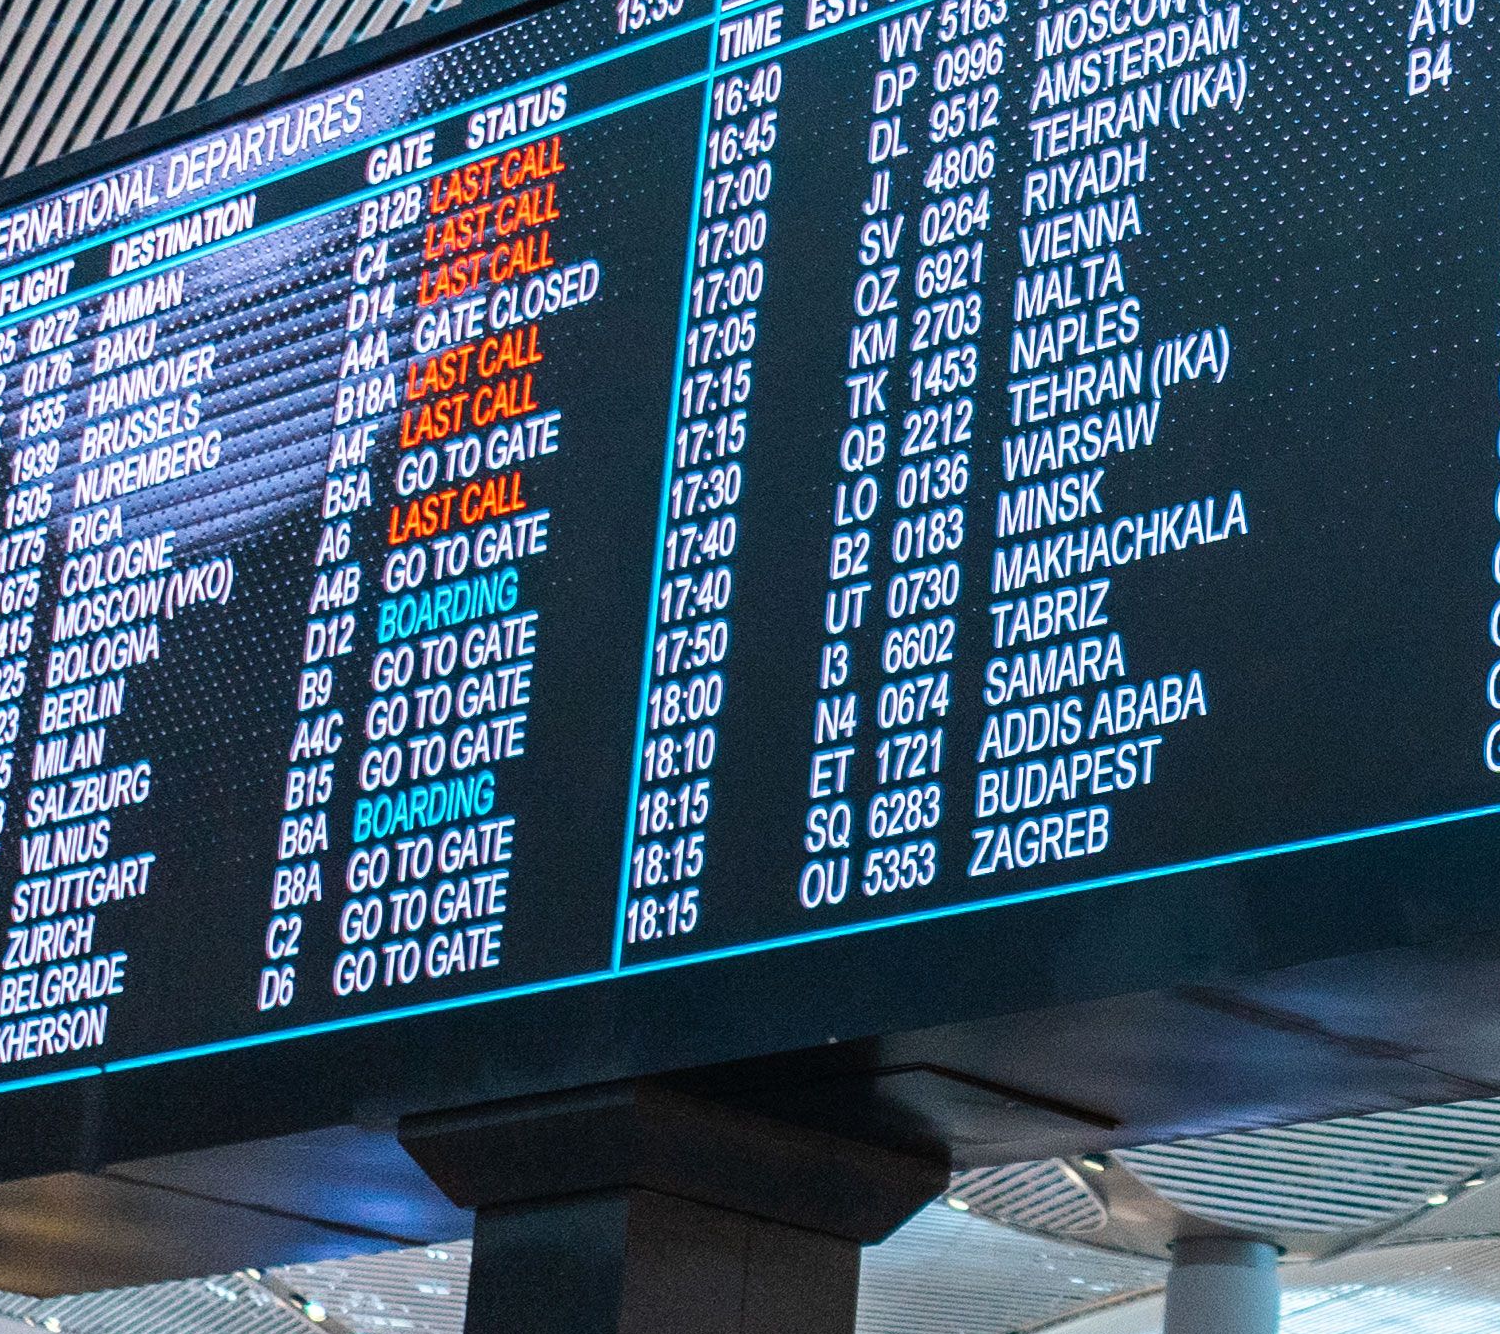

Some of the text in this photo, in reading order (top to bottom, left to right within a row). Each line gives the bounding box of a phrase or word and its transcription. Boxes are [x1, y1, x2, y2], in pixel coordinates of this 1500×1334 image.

[706, 109, 779, 170] 16:45
[871, 60, 921, 115] DP
[931, 30, 1008, 93] 0996
[717, 4, 785, 63] TIME
[108, 193, 258, 278] DESTINATION
[365, 129, 436, 185] GATE
[465, 82, 569, 151] STATUS
[164, 85, 365, 200] DEPARTURES
[696, 208, 768, 269] 17:00
[860, 168, 891, 217] JI
[922, 135, 996, 195] 4806
[1026, 81, 1163, 163] TEHRAN
[1167, 54, 1248, 130] (IKA)
[11, 436, 62, 486] 1939
[77, 390, 203, 467] BRUSSELS
[338, 328, 391, 380] A4A
[411, 295, 488, 355] GATE
[487, 259, 601, 330] CLOSED
[19, 347, 75, 398] 0176
[91, 318, 158, 376] BAKU
[351, 237, 392, 286] C4
[421, 200, 496, 263] LAST
[491, 180, 561, 238] CALL
[50, 574, 167, 644] MOSCOW
[163, 556, 235, 622] (VKO)
[313, 521, 352, 568] A6
[386, 486, 460, 547] LAST
[457, 469, 528, 526] CALL
[653, 619, 729, 677] 17:50
[824, 582, 873, 635] UT
[886, 561, 961, 620] 0730
[991, 491, 1249, 595] MAKHACHKALA
[37, 675, 126, 736] BERLIN
[303, 612, 357, 665] D12
[374, 566, 520, 645] BOARDING
[255, 964, 297, 1012] D6
[331, 948, 378, 997] GO
[380, 938, 422, 987] TO
[423, 922, 505, 979] GATE
